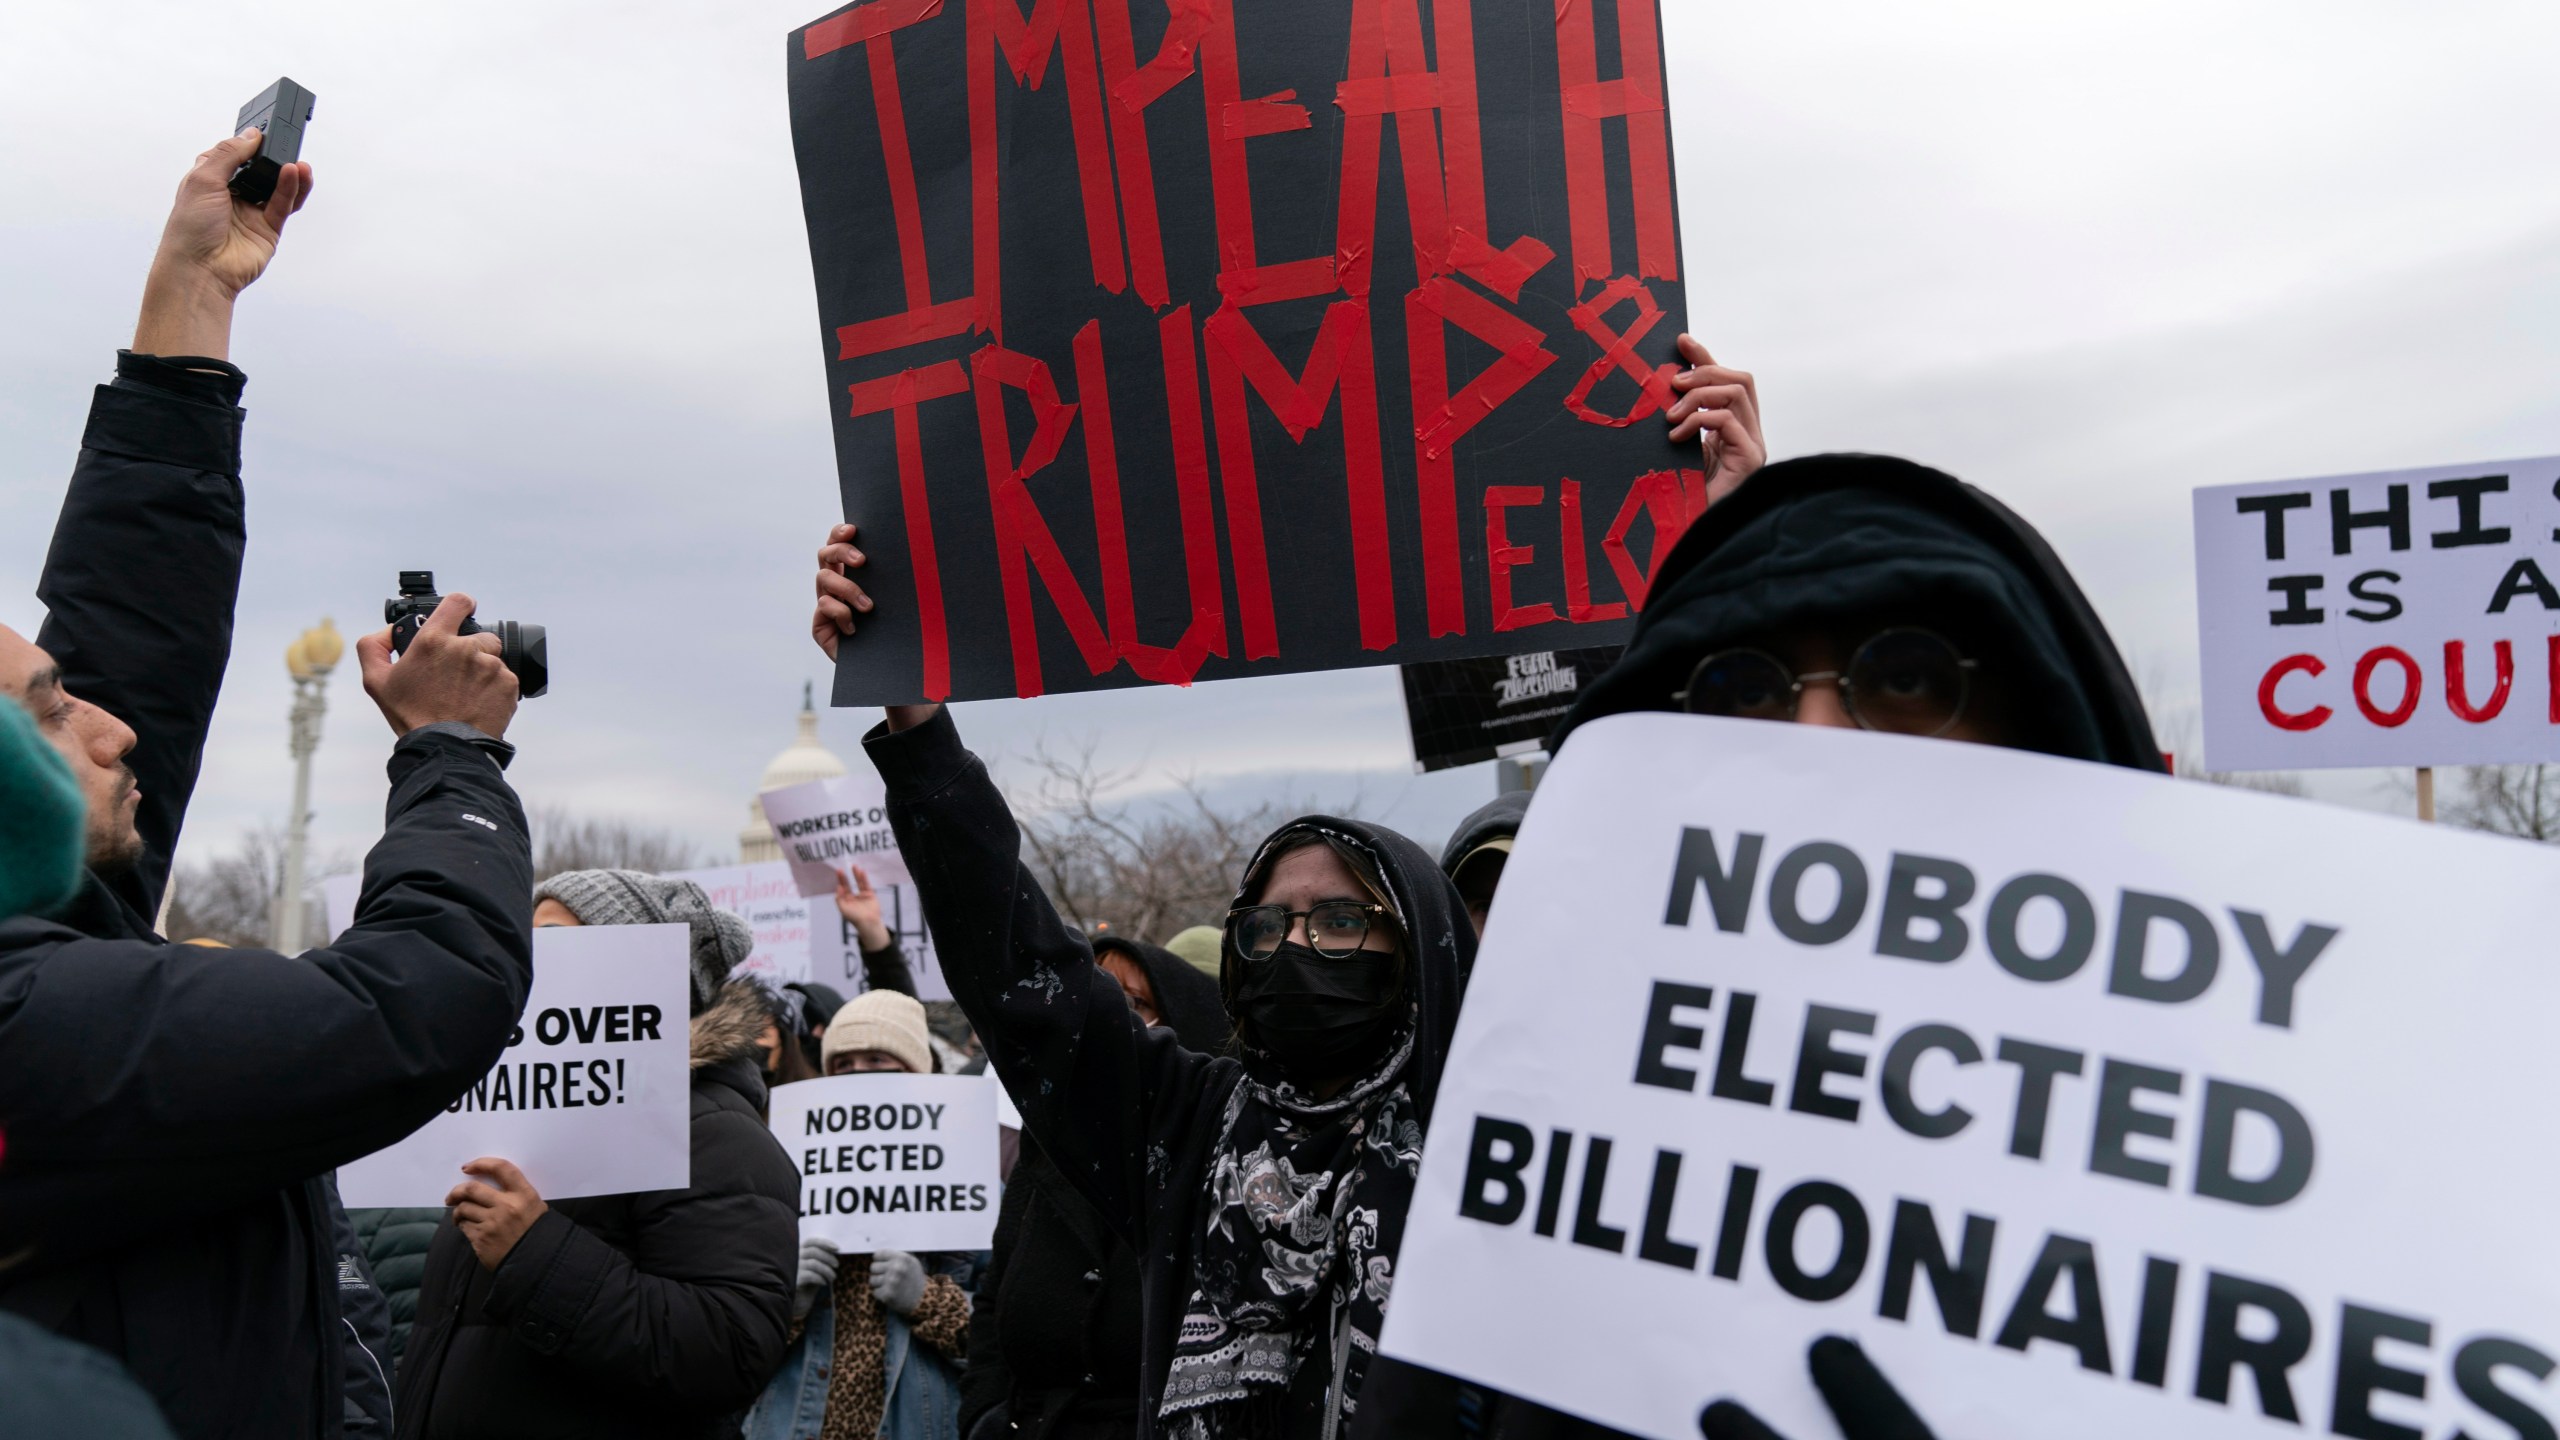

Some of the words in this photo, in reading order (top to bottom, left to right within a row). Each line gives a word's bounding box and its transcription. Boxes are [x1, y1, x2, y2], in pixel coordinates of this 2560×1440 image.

[804, 0, 1677, 360] IMPEACH
[849, 276, 1558, 702] TRUMP
[1563, 274, 1677, 427] &
[2236, 474, 2560, 560] THI
[2267, 569, 2403, 627] IS
[2485, 557, 2560, 614] A
[2257, 634, 2560, 732] COU
[777, 809, 863, 839] WORKERS
[868, 805, 889, 824] O
[1662, 825, 2343, 1031] NOBODY
[535, 1004, 662, 1047] OVER
[805, 1103, 946, 1136] NOBODY
[1631, 979, 2317, 1208] ELECTED
[803, 1143, 945, 1176] ELECTED
[1457, 1115, 2560, 1440] BILLIONAIRES
